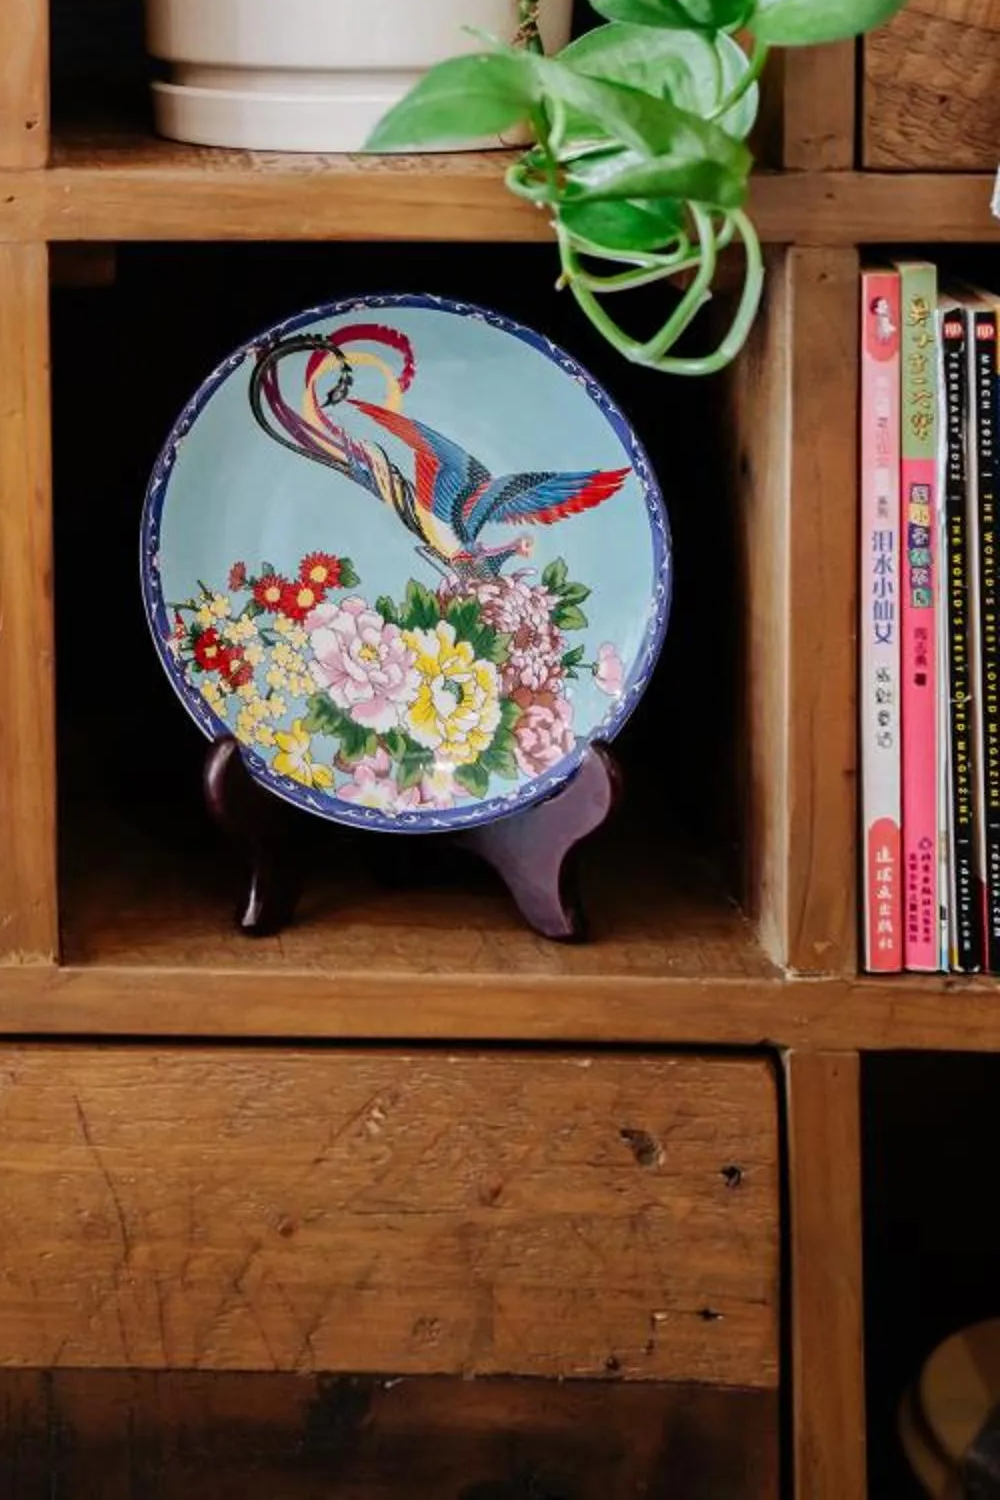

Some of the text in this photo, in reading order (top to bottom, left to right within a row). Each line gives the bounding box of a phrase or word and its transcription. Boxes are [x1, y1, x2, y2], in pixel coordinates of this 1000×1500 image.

[949, 352, 960, 434] FEBRUARY
[981, 353, 991, 409] MARCH
[950, 442, 961, 481] 2022
[981, 418, 993, 457] 2022
[951, 515, 962, 546] THE
[983, 493, 993, 522] THE
[872, 530, 894, 644] 泪水小仙女
[952, 553, 964, 625] WORLD'S
[984, 531, 995, 606] WORLD'S
[954, 633, 965, 672] BEST
[985, 613, 997, 652] BEST
[955, 681, 966, 732] LOVED
[987, 662, 998, 713] LOVED
[957, 740, 969, 825] MAGAZINE
[988, 723, 1000, 807] MAGAZINE
